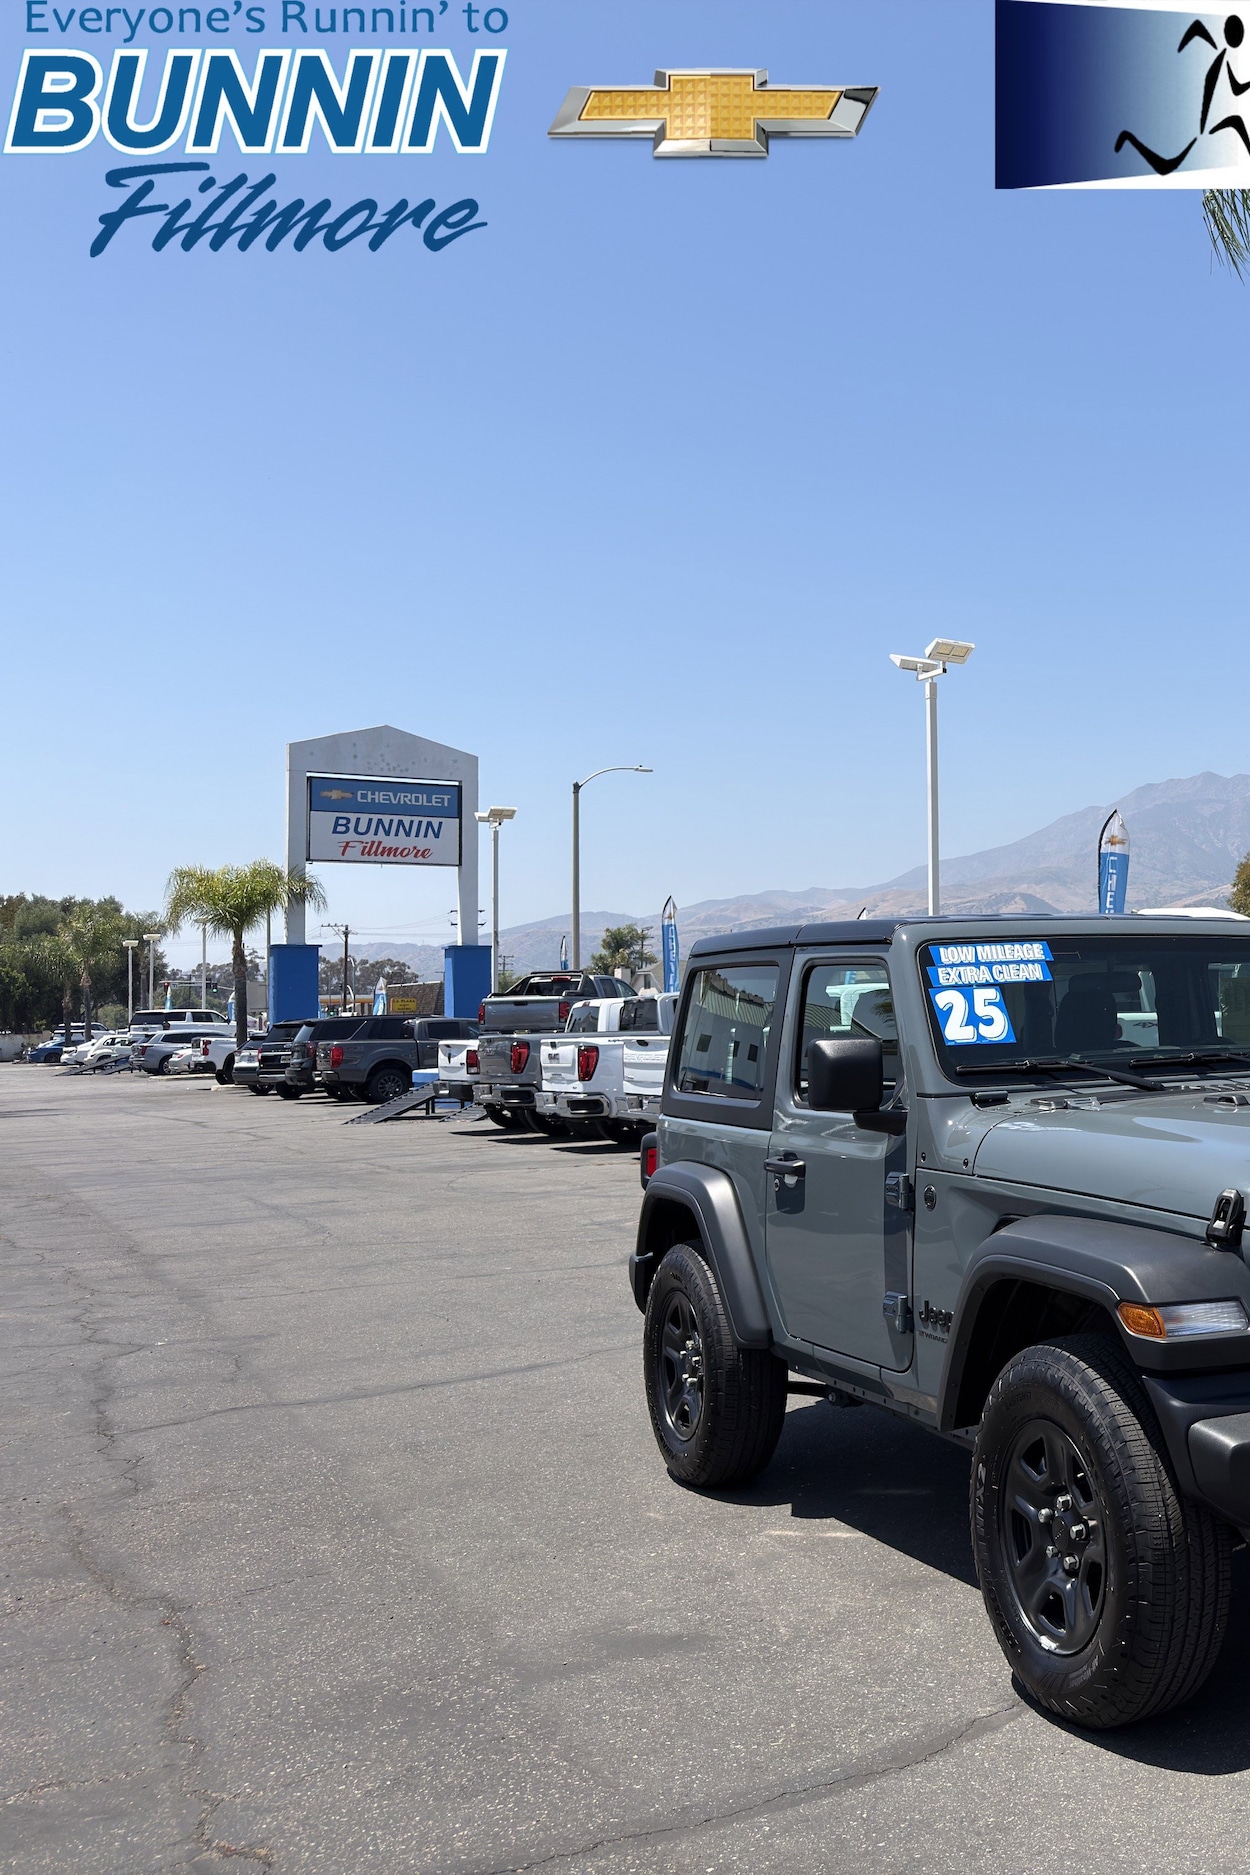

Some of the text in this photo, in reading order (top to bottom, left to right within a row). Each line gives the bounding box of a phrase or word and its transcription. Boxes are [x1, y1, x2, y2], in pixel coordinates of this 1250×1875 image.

[357, 790, 451, 807] CHEVROLET
[332, 816, 443, 839] BUNNIN
[337, 840, 433, 860] Fillmore
[939, 943, 1045, 965] LOW MILEAGE
[938, 963, 1043, 985] EXTRA CLEAN
[934, 988, 1009, 1043] 25
